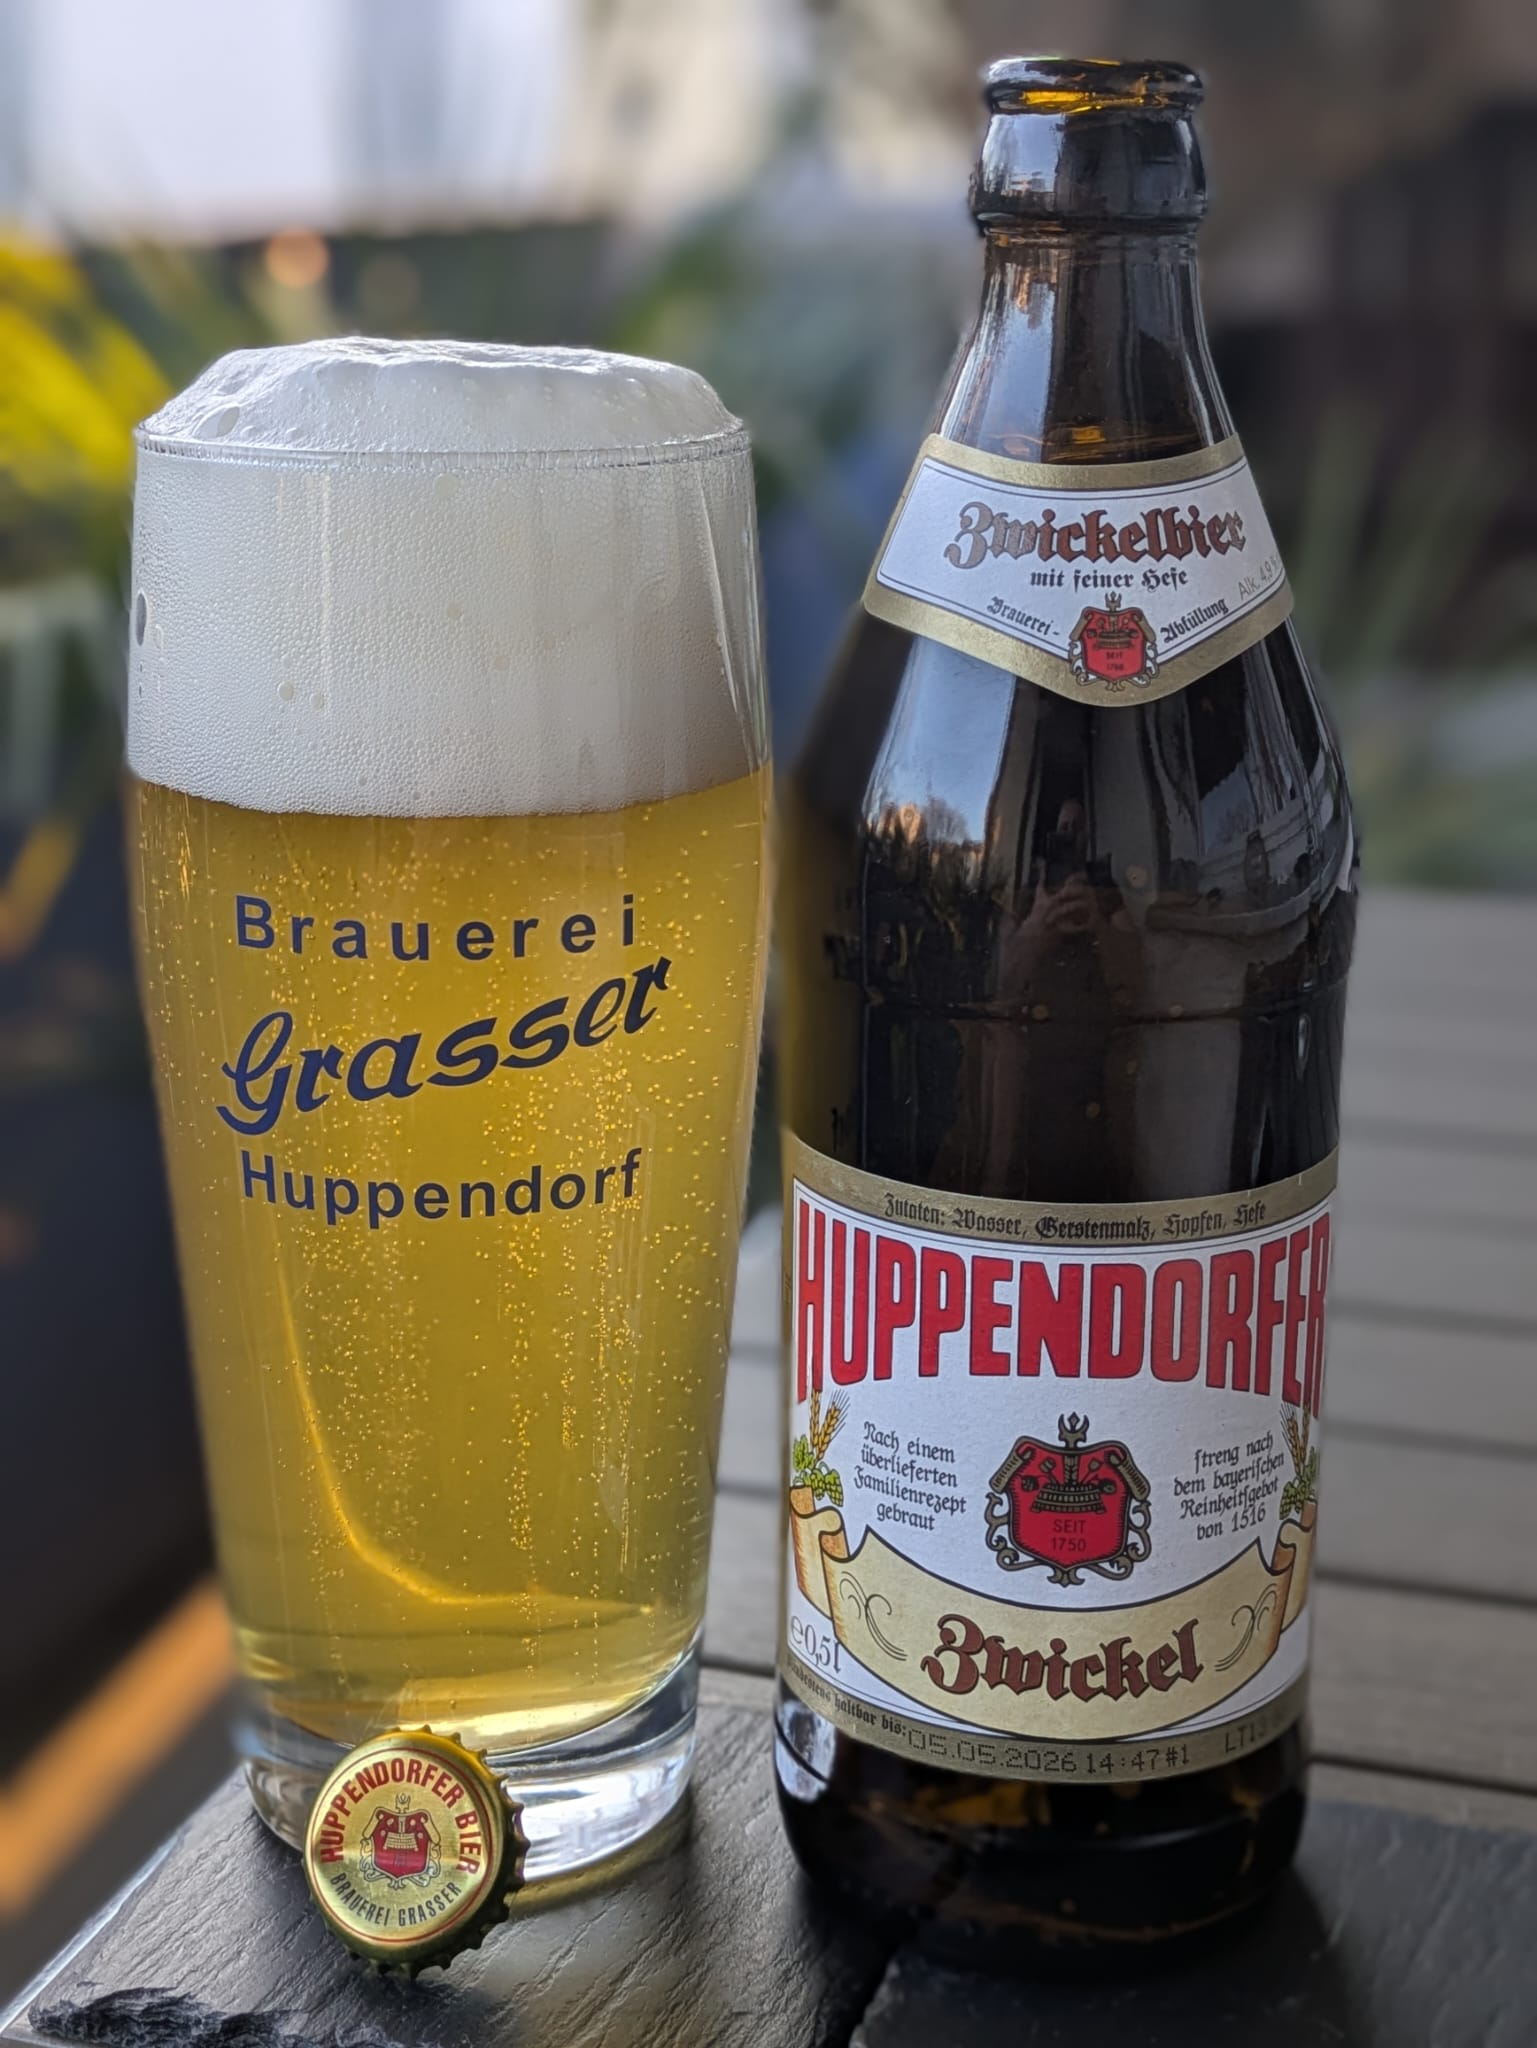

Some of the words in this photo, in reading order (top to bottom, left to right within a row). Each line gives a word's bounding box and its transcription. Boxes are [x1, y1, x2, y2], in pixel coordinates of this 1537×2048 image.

[943, 501, 1247, 569] Zwickelbier
[1030, 569, 1065, 588] mit
[1073, 568, 1134, 593] feiner
[1142, 569, 1188, 594] Hefe
[1160, 598, 1229, 644] Abfüllung
[235, 894, 635, 961] Brauerei
[215, 956, 672, 1135] Grasser
[241, 1147, 642, 1229] Huppendorf
[952, 1207, 1027, 1239] Wasser,
[1035, 1215, 1154, 1241] Gerstenmalz,
[1164, 1210, 1226, 1238] Hopfen,
[1232, 1201, 1266, 1226] Hefe
[797, 1198, 1330, 1420] HUPPENDORFER
[864, 1421, 899, 1454] Nach
[907, 1437, 955, 1463] einem
[1246, 1430, 1273, 1456] nach
[861, 1444, 958, 1488] überlieferten
[1174, 1477, 1206, 1496] dem
[854, 1465, 967, 1516] Familienrezept
[877, 1503, 935, 1531] gebraut
[1053, 1519, 1087, 1534] SEIT
[1197, 1521, 1223, 1540] von
[1232, 1502, 1266, 1532] 1516
[1052, 1537, 1087, 1552] 1750
[921, 1613, 1205, 1702] Zwickel
[834, 1692, 877, 1726] haltbar
[881, 1714, 906, 1737] bis:
[908, 1728, 1077, 1772] 05.05.2026
[319, 1757, 465, 1864] HUPPENDORFER
[454, 1810, 483, 1875] BIER
[330, 1872, 391, 1927] BRAUEREI
[398, 1881, 462, 1927] GRASSER
